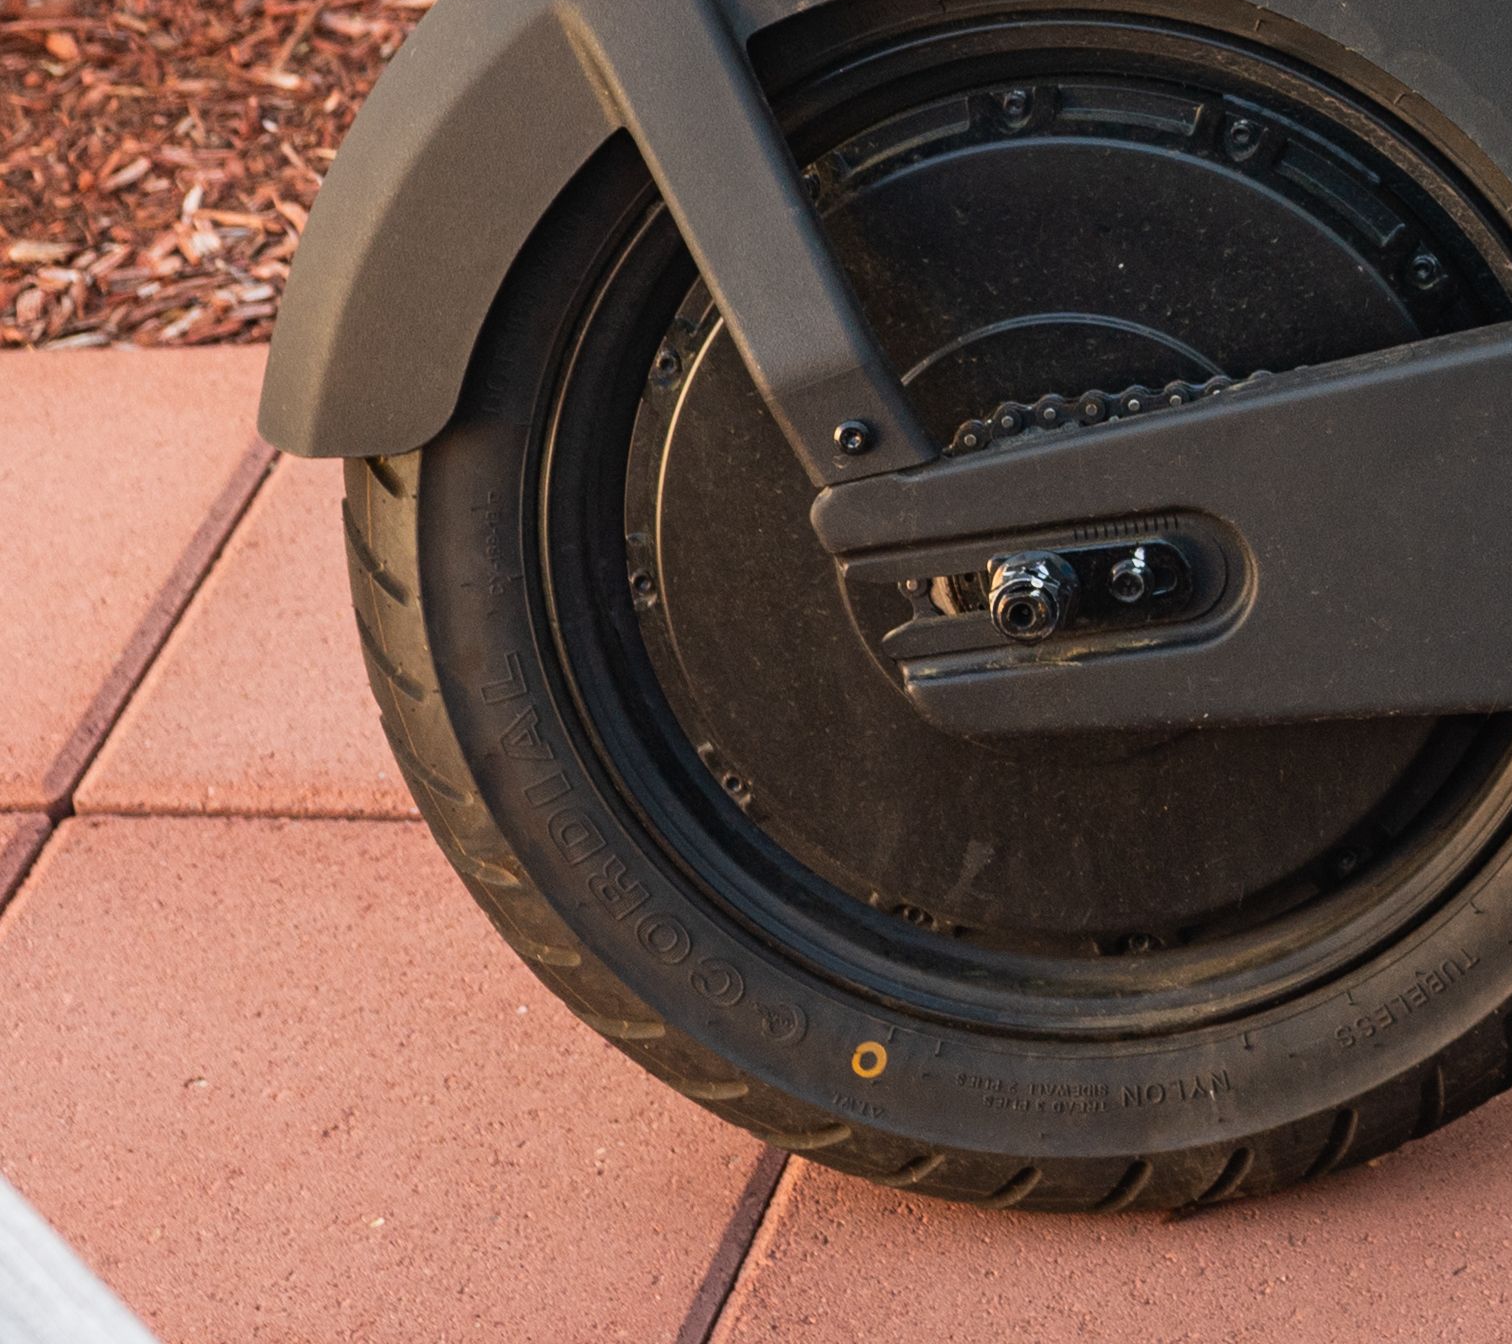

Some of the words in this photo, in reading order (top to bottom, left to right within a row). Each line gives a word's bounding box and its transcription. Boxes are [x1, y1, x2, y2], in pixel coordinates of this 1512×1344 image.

[480, 650, 745, 1008] CORDIAL
[1333, 946, 1481, 1048] TUBELESS
[951, 1070, 1004, 1093] PLIES
[1026, 1081, 1110, 1097] SIDEWALL
[1121, 1069, 1232, 1110] NYLON
[980, 1093, 1030, 1112] PLIES
[1049, 1098, 1107, 1114] TREAD
